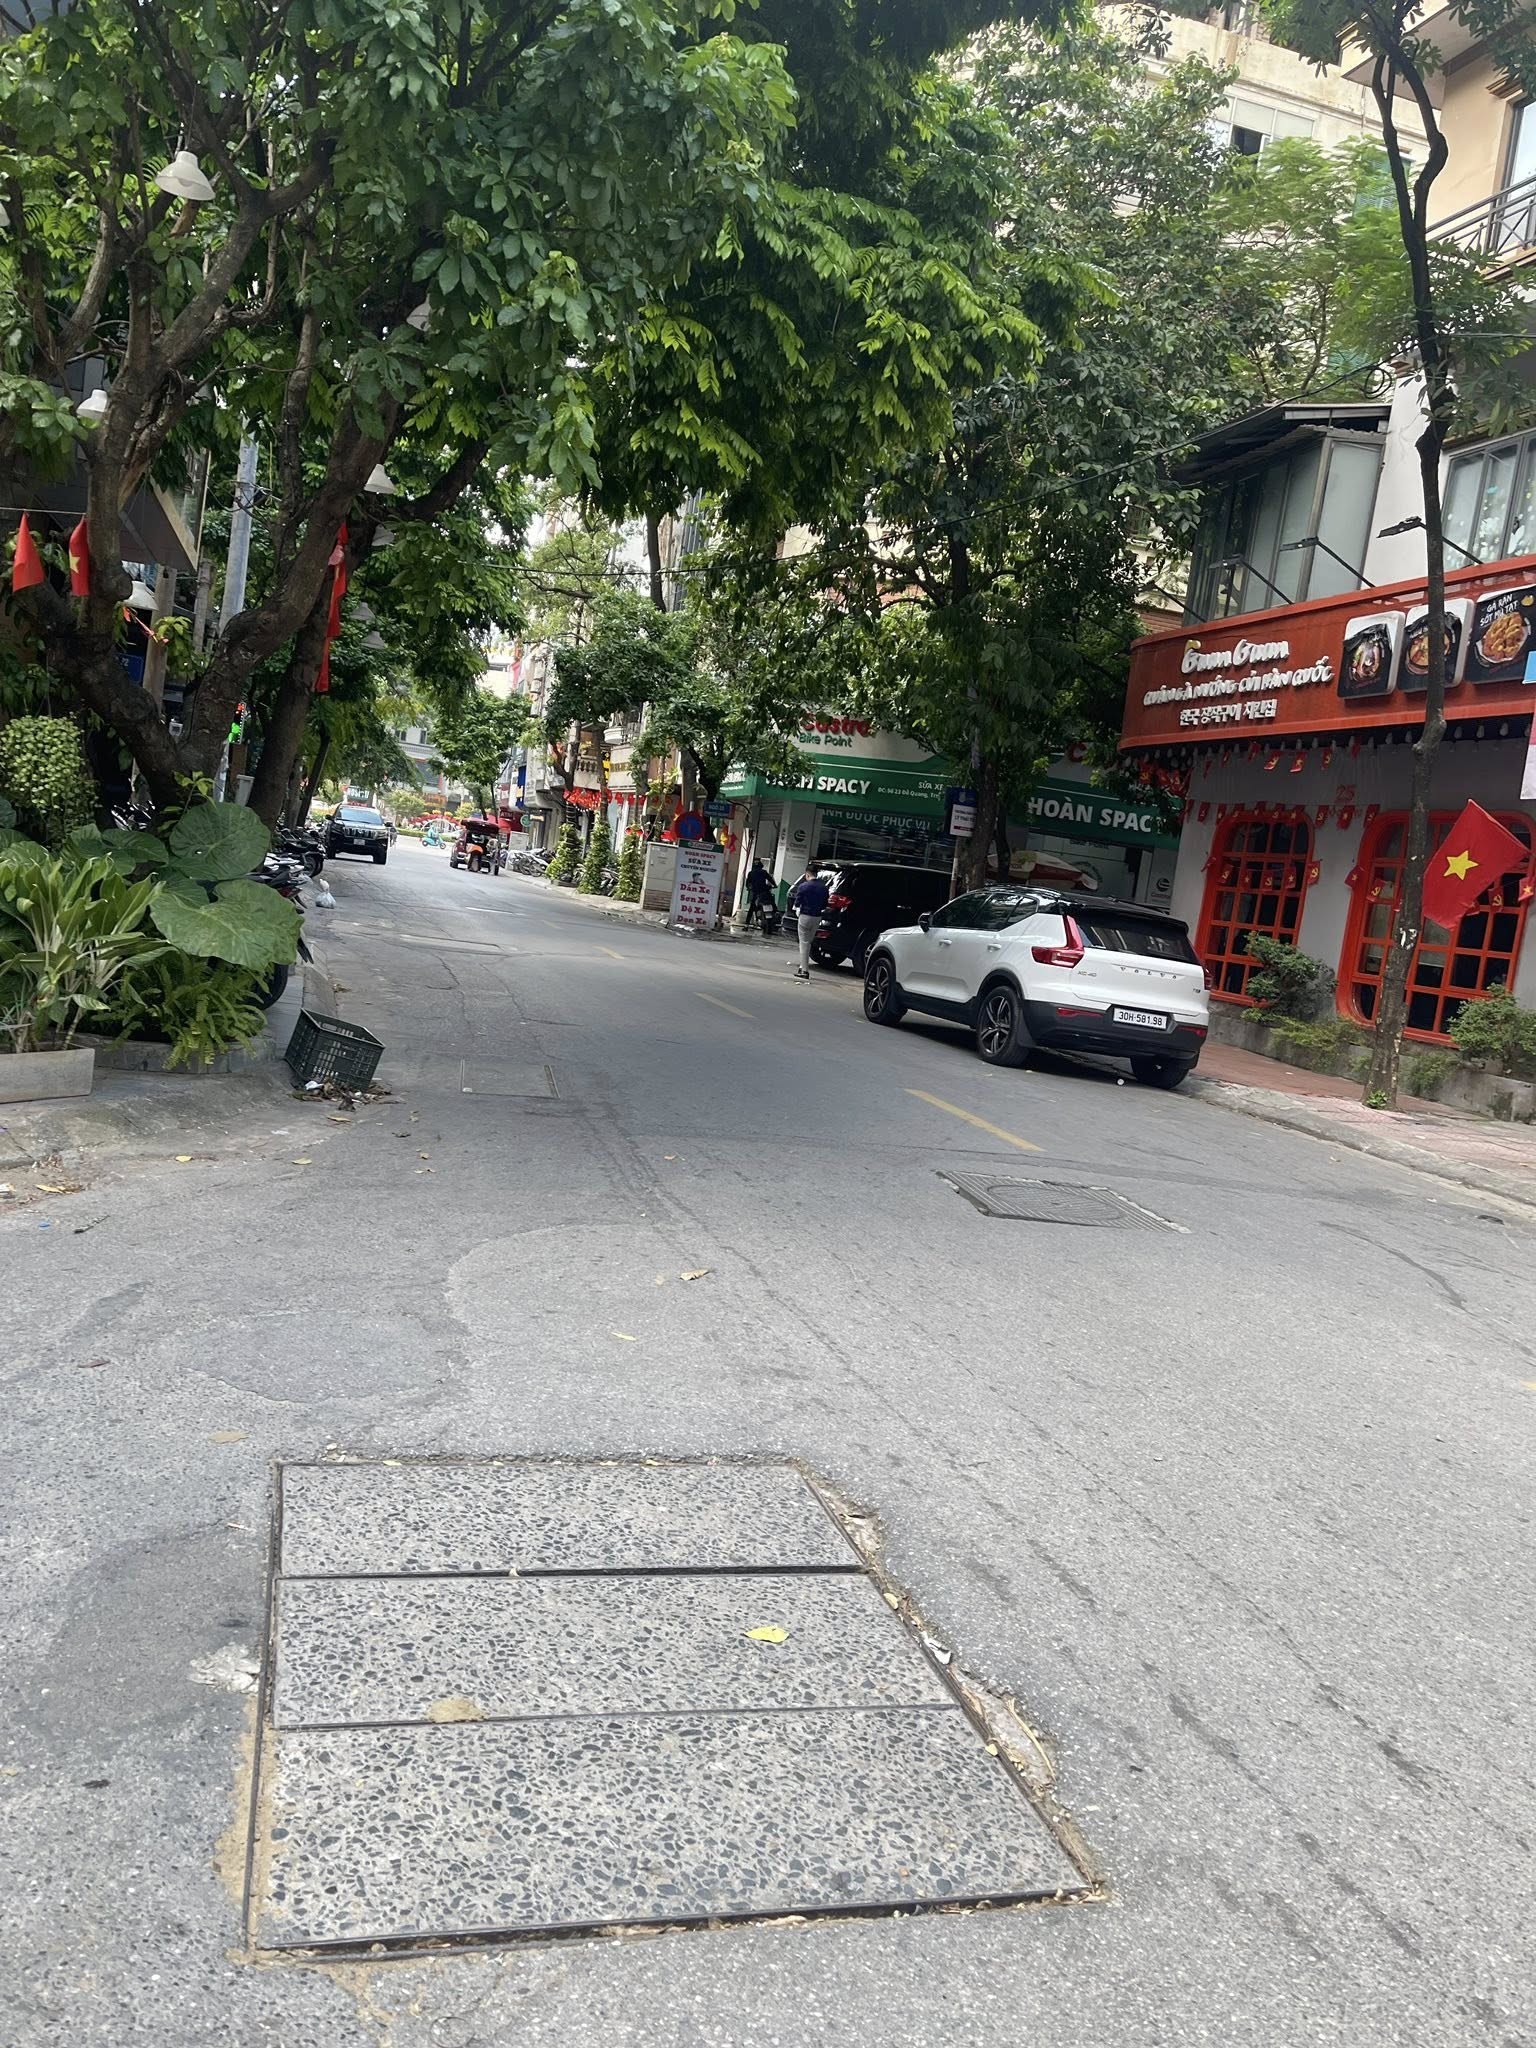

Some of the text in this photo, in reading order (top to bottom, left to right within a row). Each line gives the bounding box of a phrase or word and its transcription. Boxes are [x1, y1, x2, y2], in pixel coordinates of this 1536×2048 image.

[1143, 684, 1175, 706] QUÁN
[1192, 674, 1236, 698] NƯỚNG
[1238, 670, 1261, 692] CỦI
[1261, 668, 1293, 690] HÀN
[1292, 655, 1335, 687] QUỐC
[1179, 698, 1278, 726] 한국 장작구이 치킨집
[802, 713, 873, 738] Castro
[799, 732, 853, 748] Bike Point
[817, 775, 871, 795] SPACY
[1027, 796, 1093, 824] HOÀN
[698, 886, 711, 894] Xe
[697, 896, 709, 904] Xe
[694, 906, 706, 915] Xe
[695, 917, 707, 926] Xe
[1120, 966, 1178, 980] VOLVO
[1118, 1010, 1164, 1027] 30H-581.98
